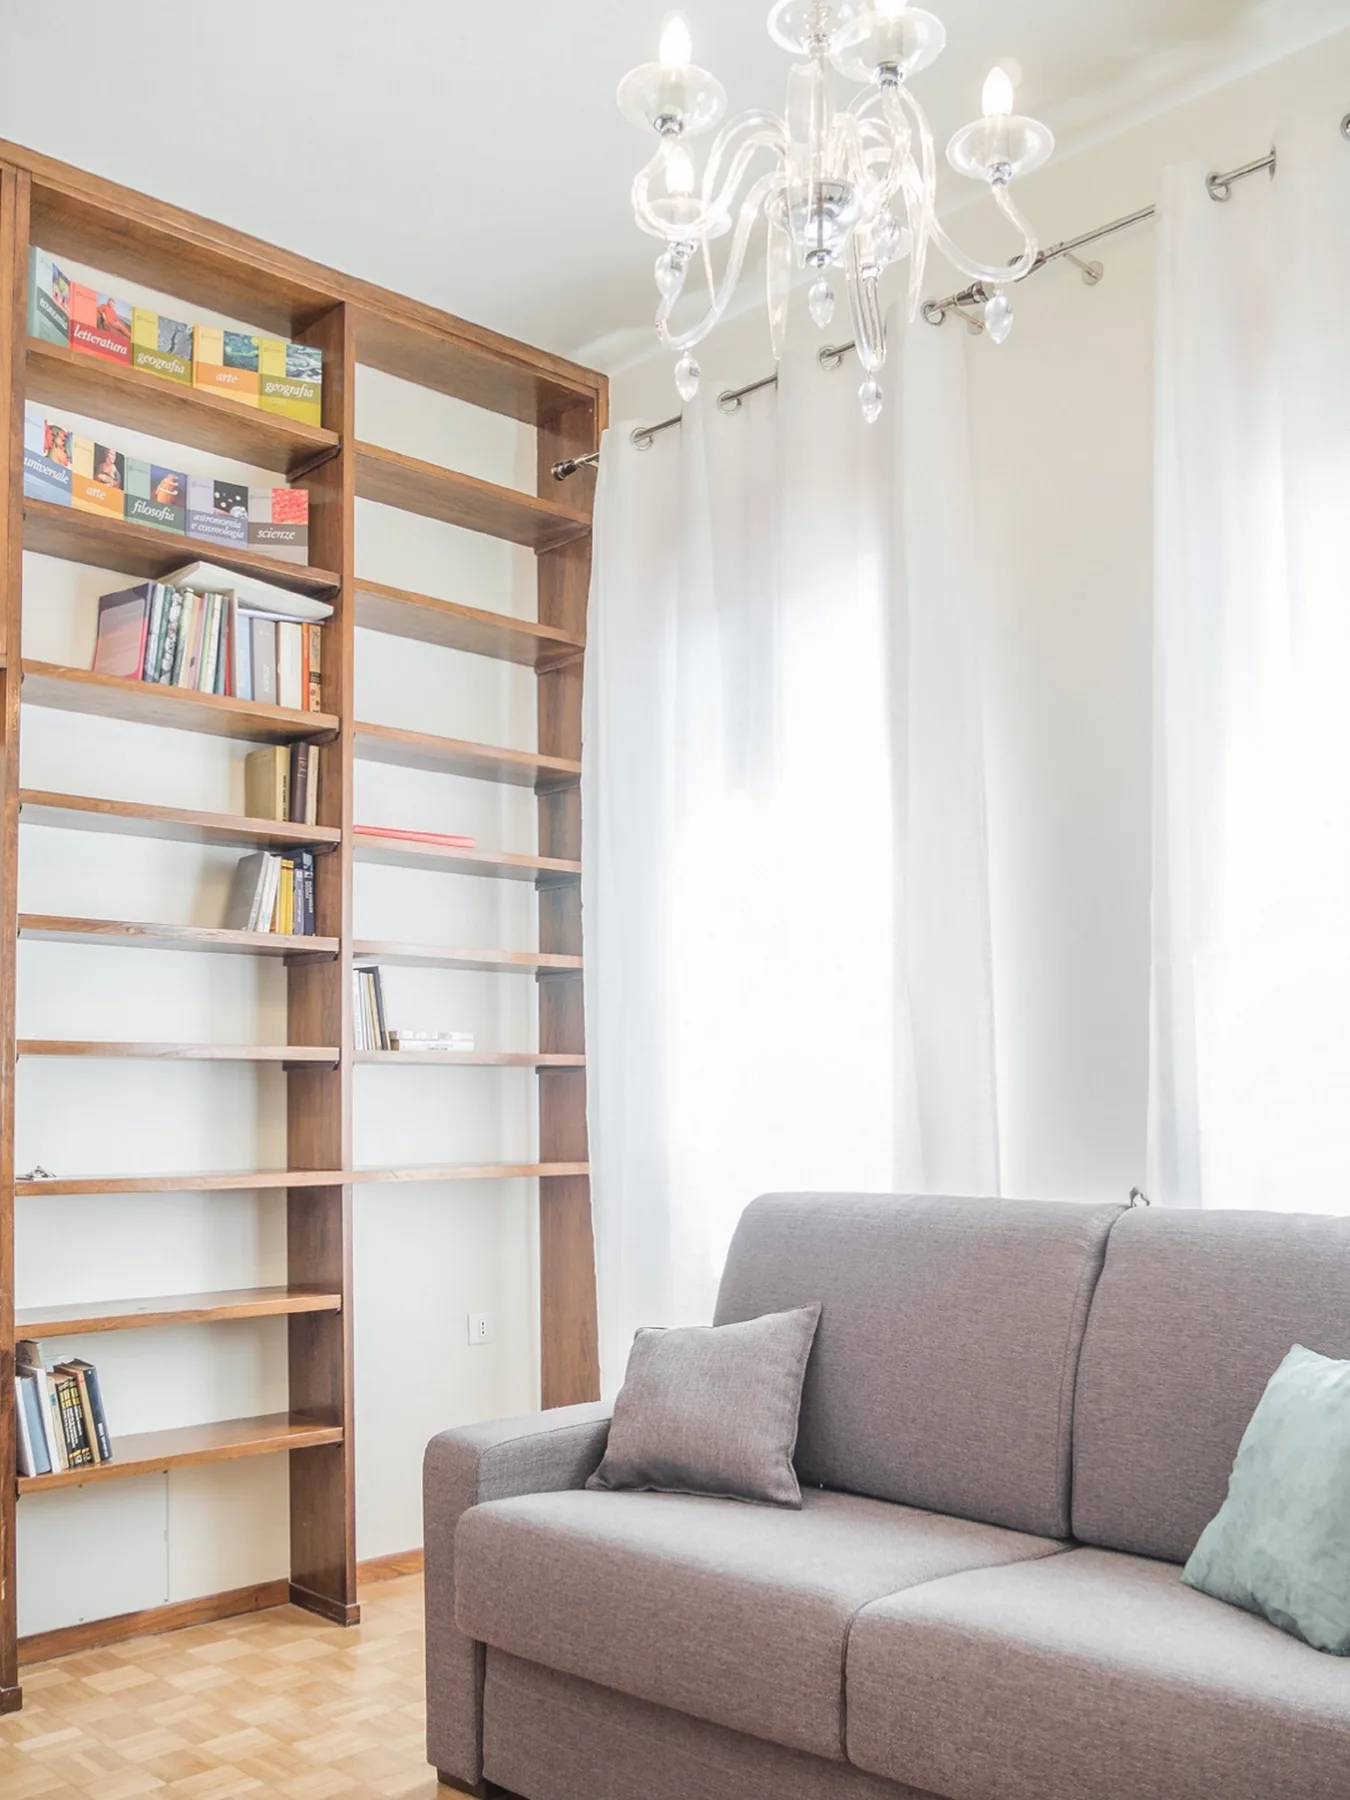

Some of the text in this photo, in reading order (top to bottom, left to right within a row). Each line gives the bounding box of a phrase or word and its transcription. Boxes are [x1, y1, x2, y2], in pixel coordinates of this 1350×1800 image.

[73, 324, 127, 355] letteratura
[137, 352, 185, 374] geografia
[216, 372, 238, 384] arte
[265, 381, 314, 397] geografia
[24, 457, 70, 484] universale
[86, 487, 106, 500] arte
[131, 500, 175, 522] filosofia
[193, 514, 242, 529] astronomia
[197, 524, 244, 539] cosmologia
[256, 527, 296, 540] scienze
